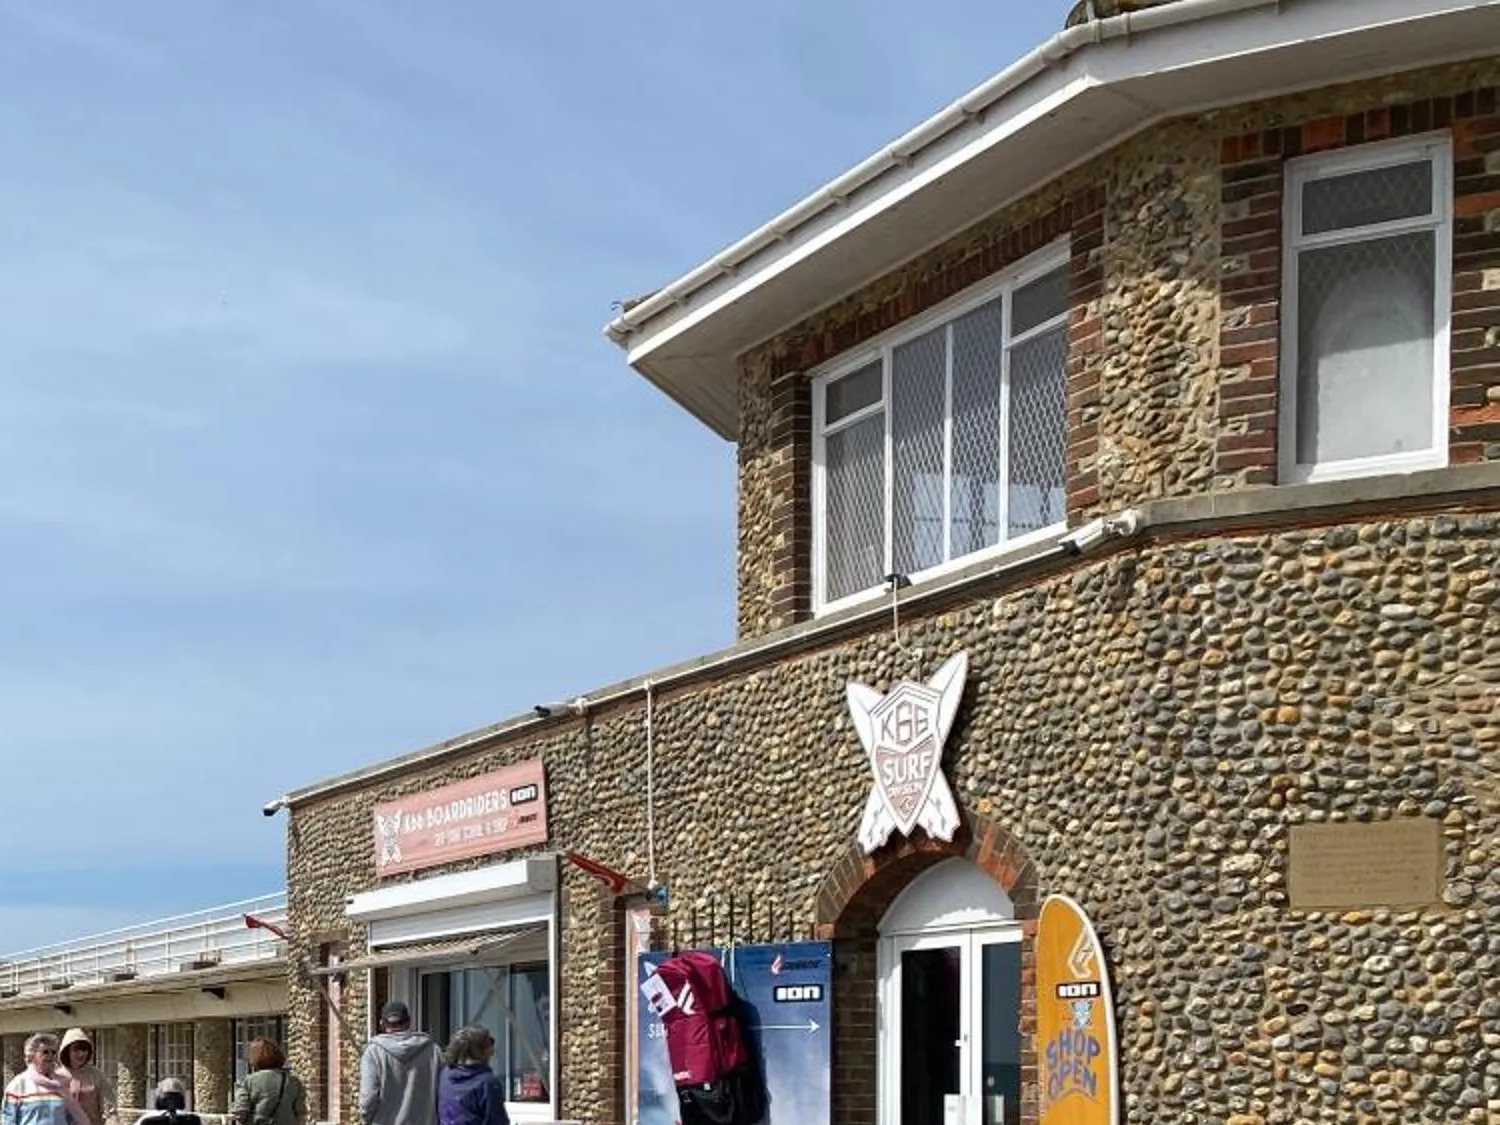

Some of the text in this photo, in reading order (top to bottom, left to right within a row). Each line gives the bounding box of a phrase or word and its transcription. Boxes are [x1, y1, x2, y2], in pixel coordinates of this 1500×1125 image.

[884, 754, 931, 787] SURF
[1046, 1027, 1100, 1068] SHOP
[1047, 1057, 1097, 1097] OPEN
